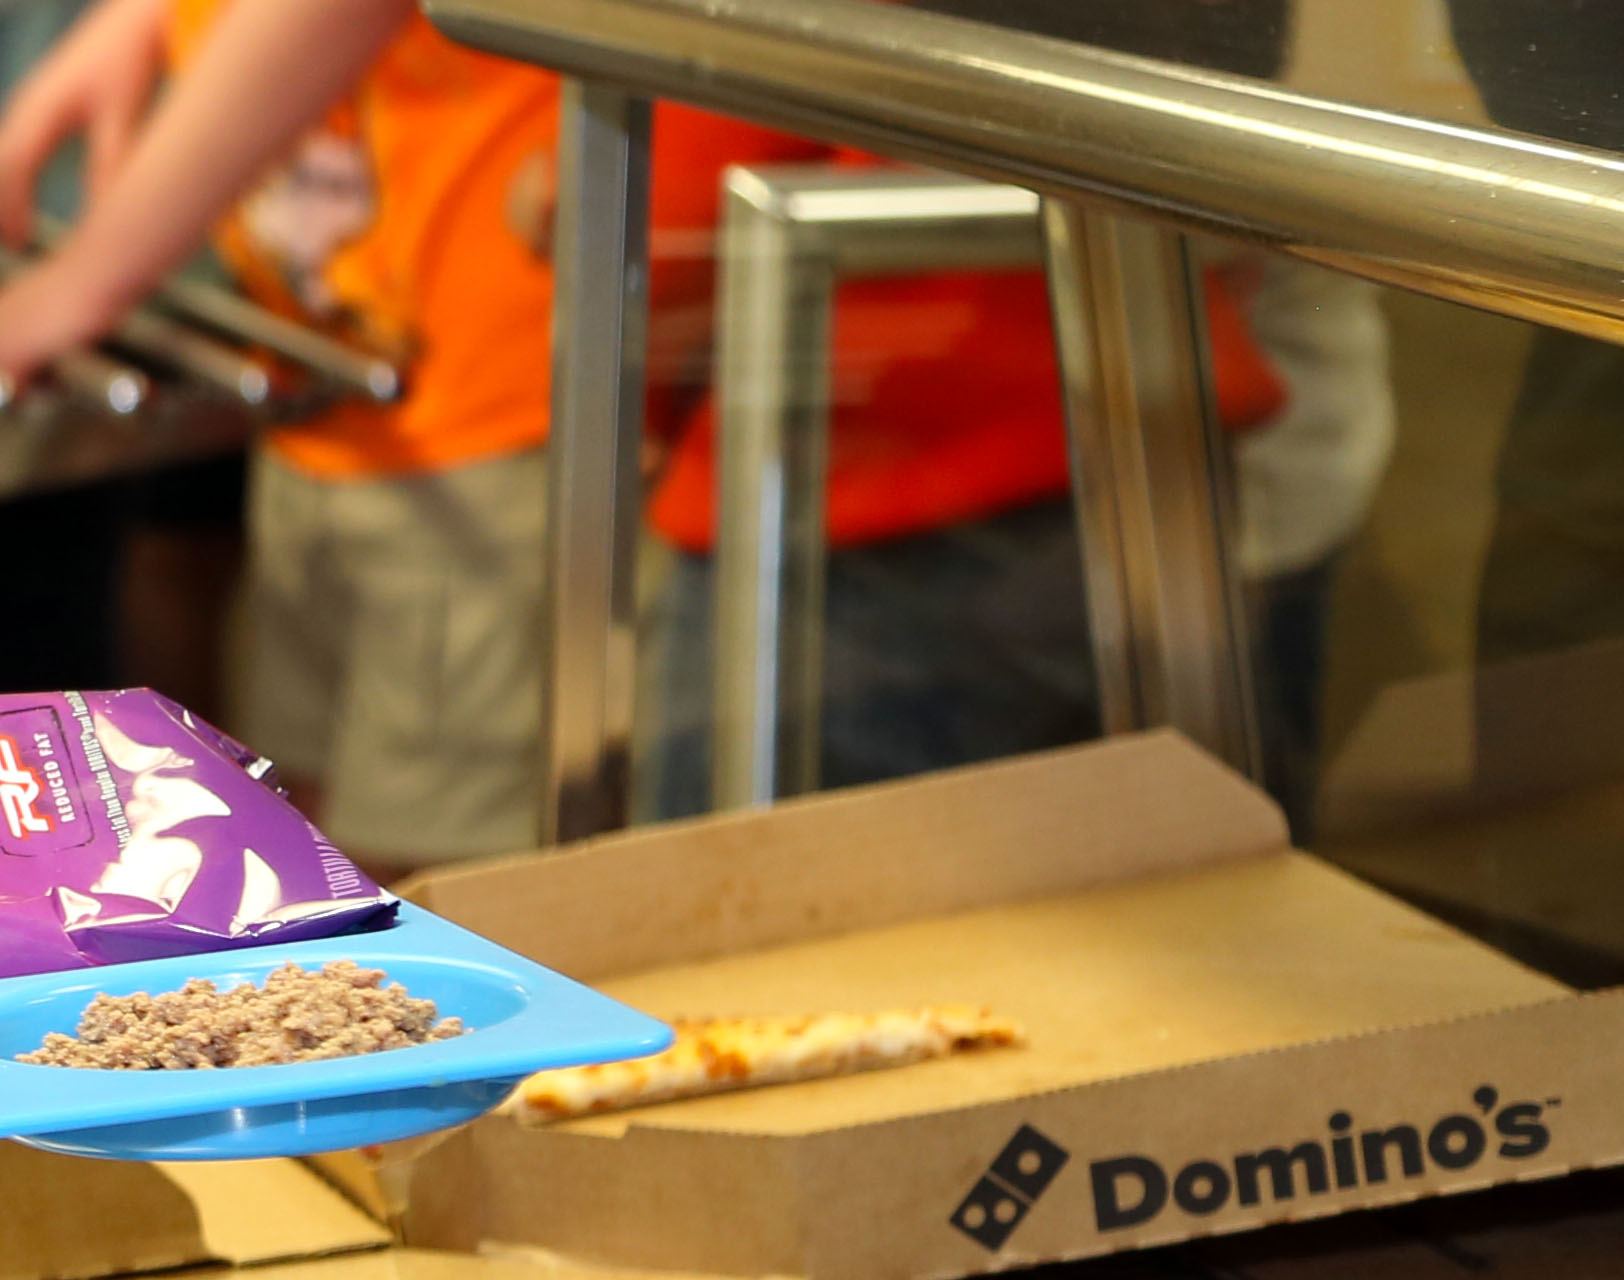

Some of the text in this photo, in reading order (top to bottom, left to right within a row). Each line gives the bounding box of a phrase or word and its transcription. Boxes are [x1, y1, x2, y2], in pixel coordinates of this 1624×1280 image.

[33, 732, 77, 823] REDUCED FAT
[1090, 1085, 1551, 1232] Domino's
